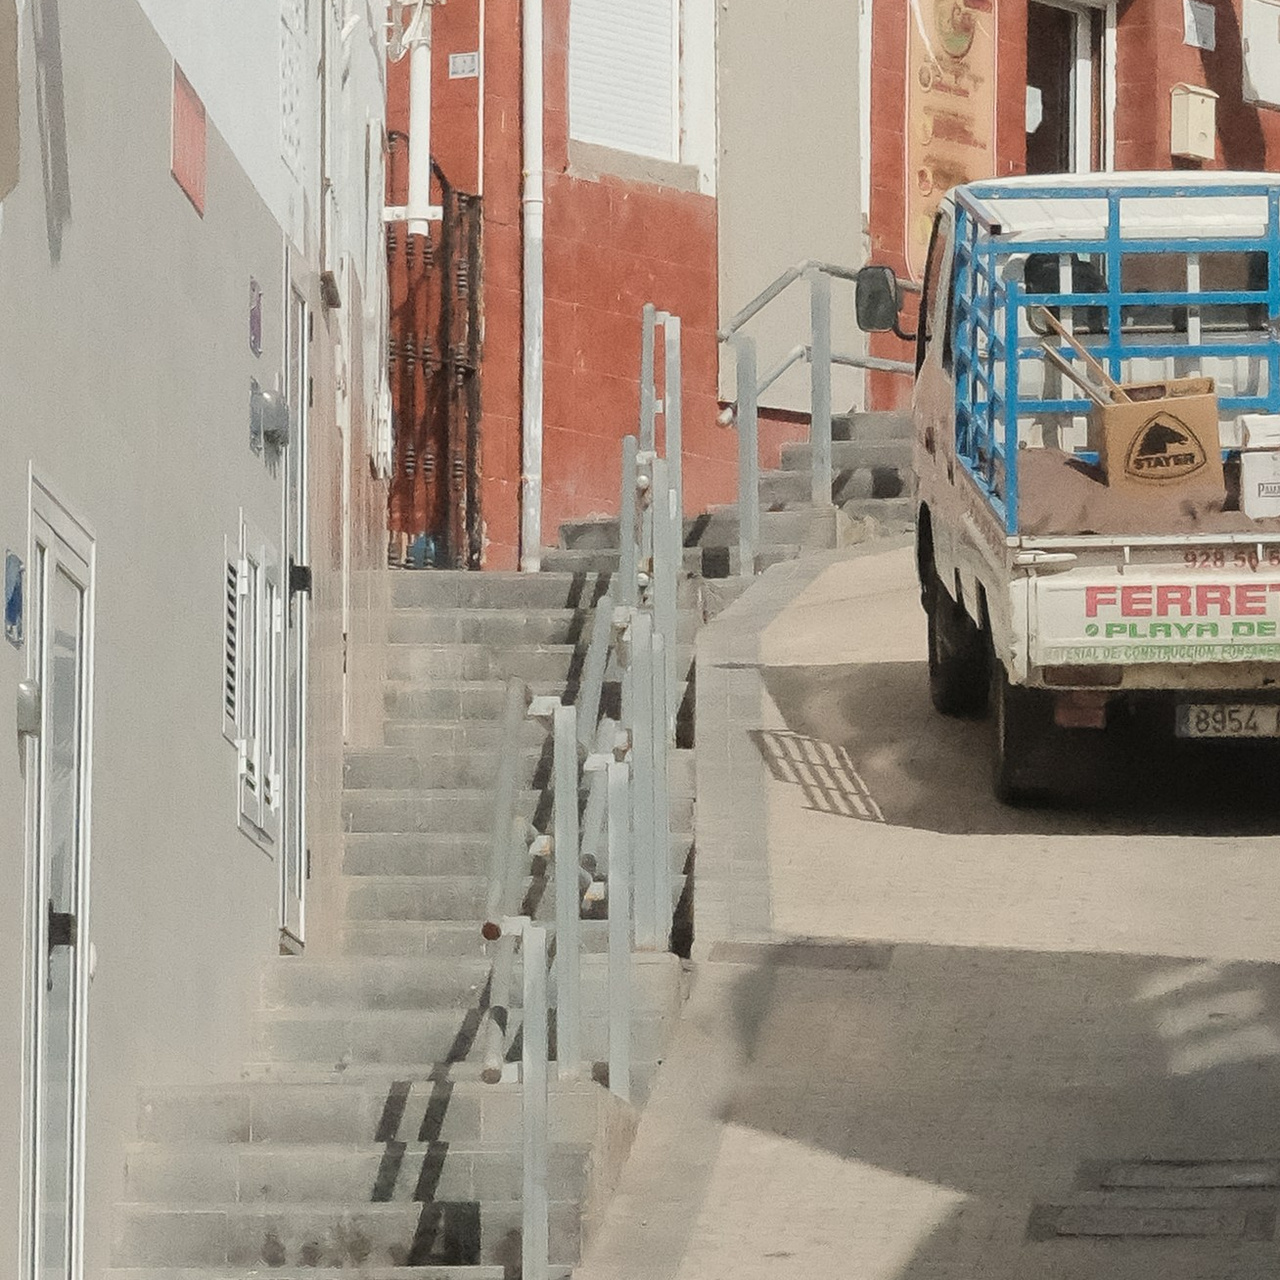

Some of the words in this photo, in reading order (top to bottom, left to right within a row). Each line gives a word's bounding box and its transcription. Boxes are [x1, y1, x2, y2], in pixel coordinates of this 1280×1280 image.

[1133, 452, 1196, 470] STAYER
[1184, 550, 1225, 568] 928
[1105, 622, 1219, 638] PLAYA
[1232, 621, 1277, 638] DE
[1195, 709, 1258, 734] 8954
